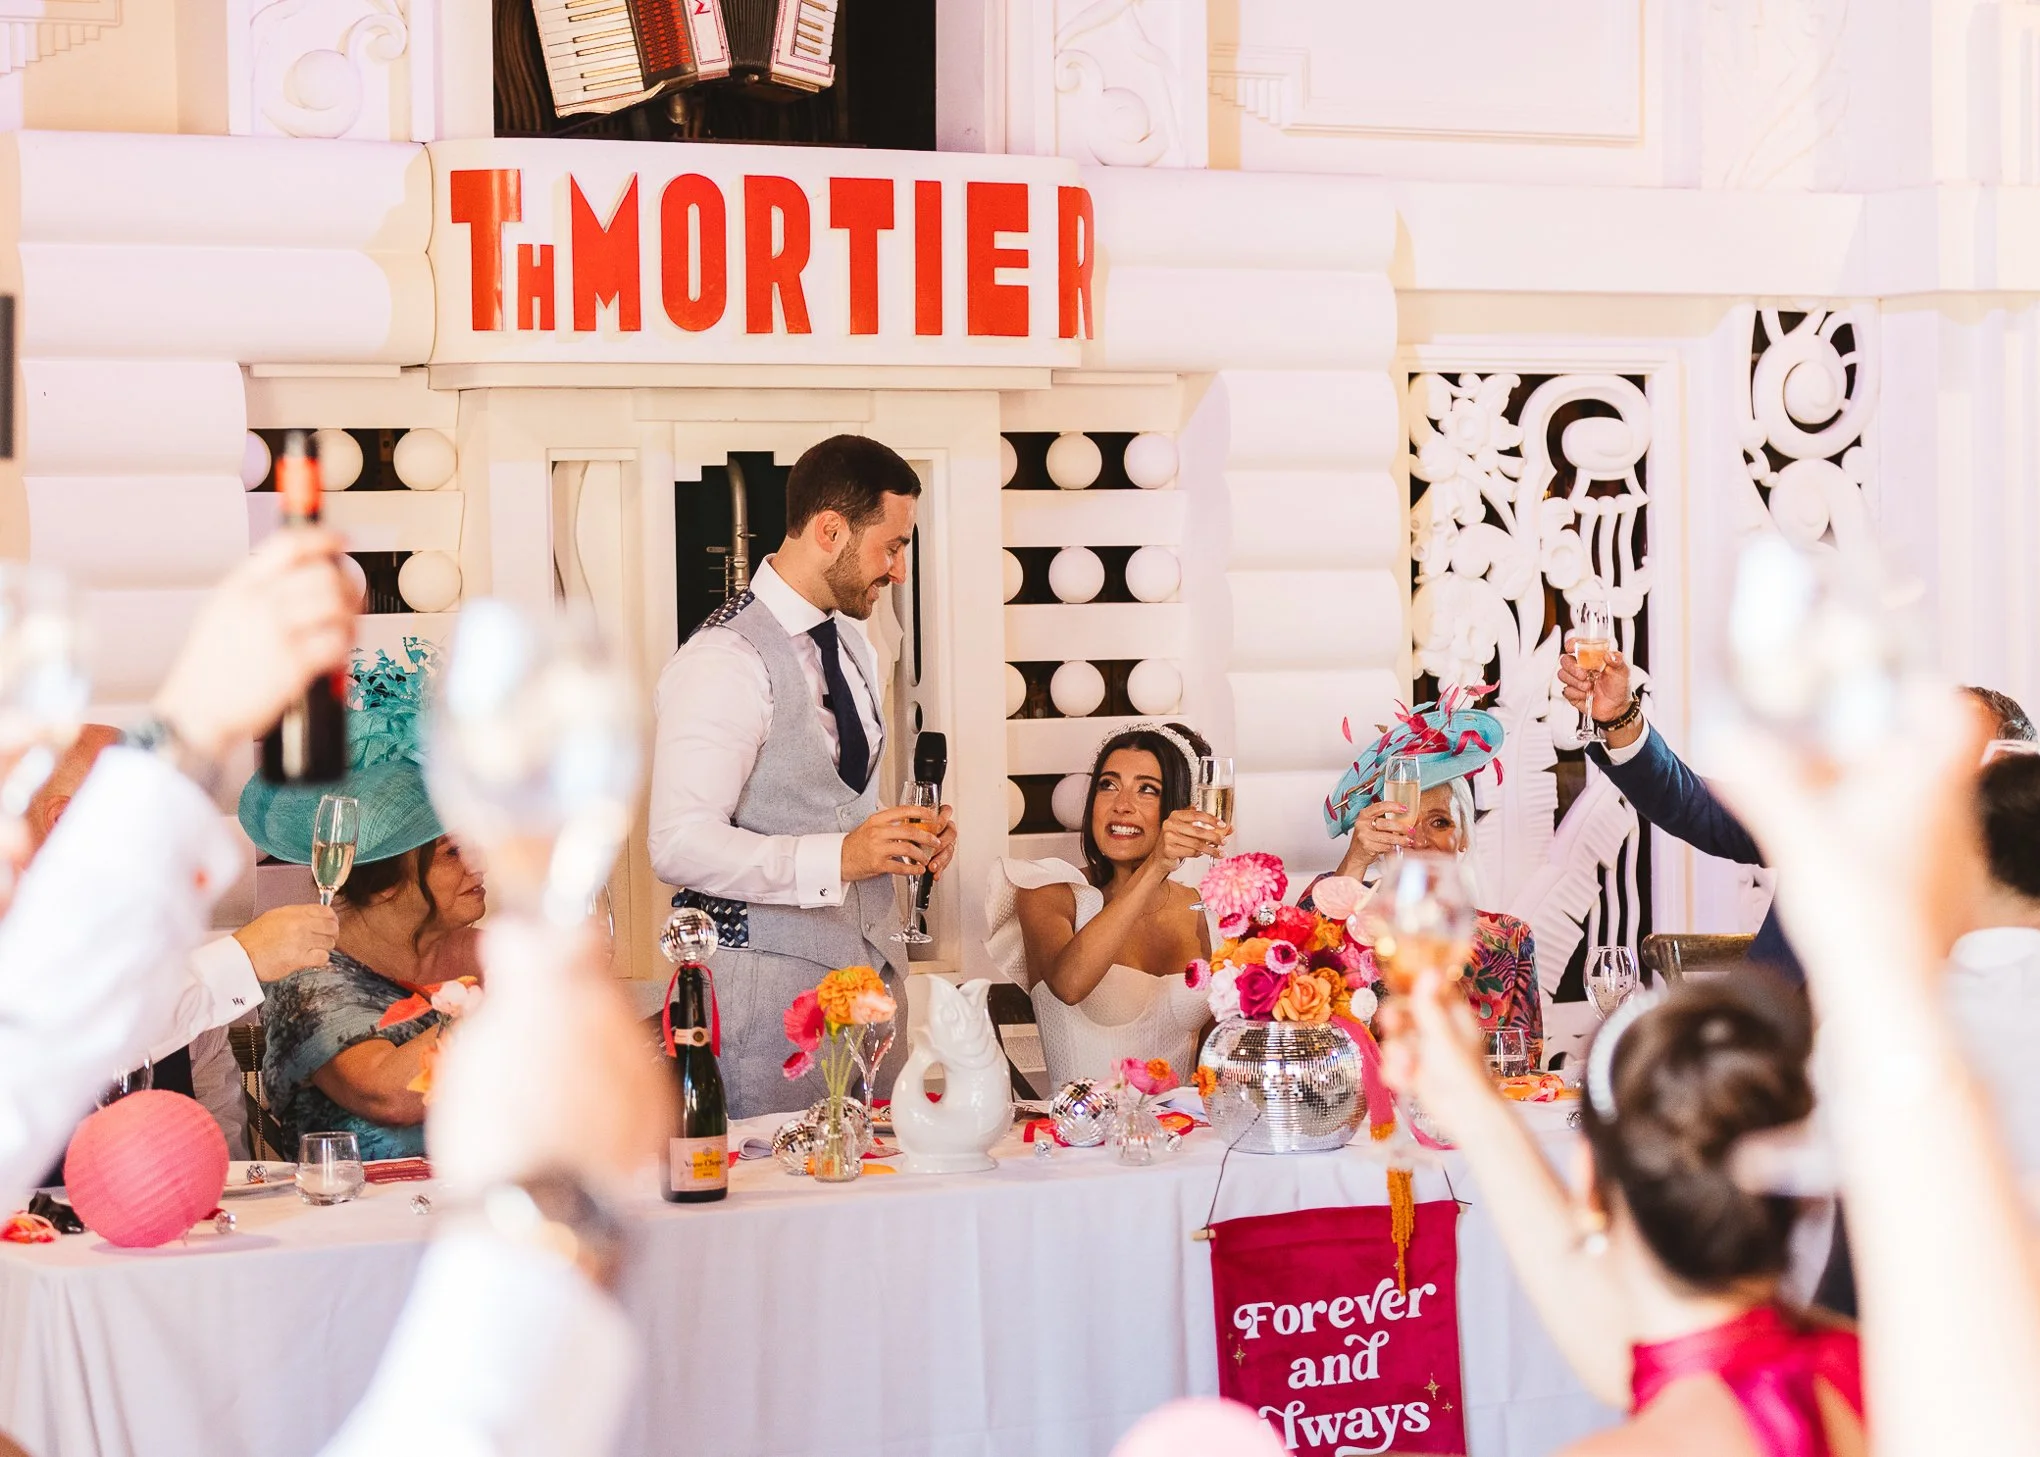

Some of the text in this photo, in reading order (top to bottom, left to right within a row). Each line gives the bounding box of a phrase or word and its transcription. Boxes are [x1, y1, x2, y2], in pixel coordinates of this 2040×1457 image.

[1233, 1277, 1437, 1340] Forever
[1288, 1330, 1390, 1389] and
[1257, 1400, 1431, 1457] lways
